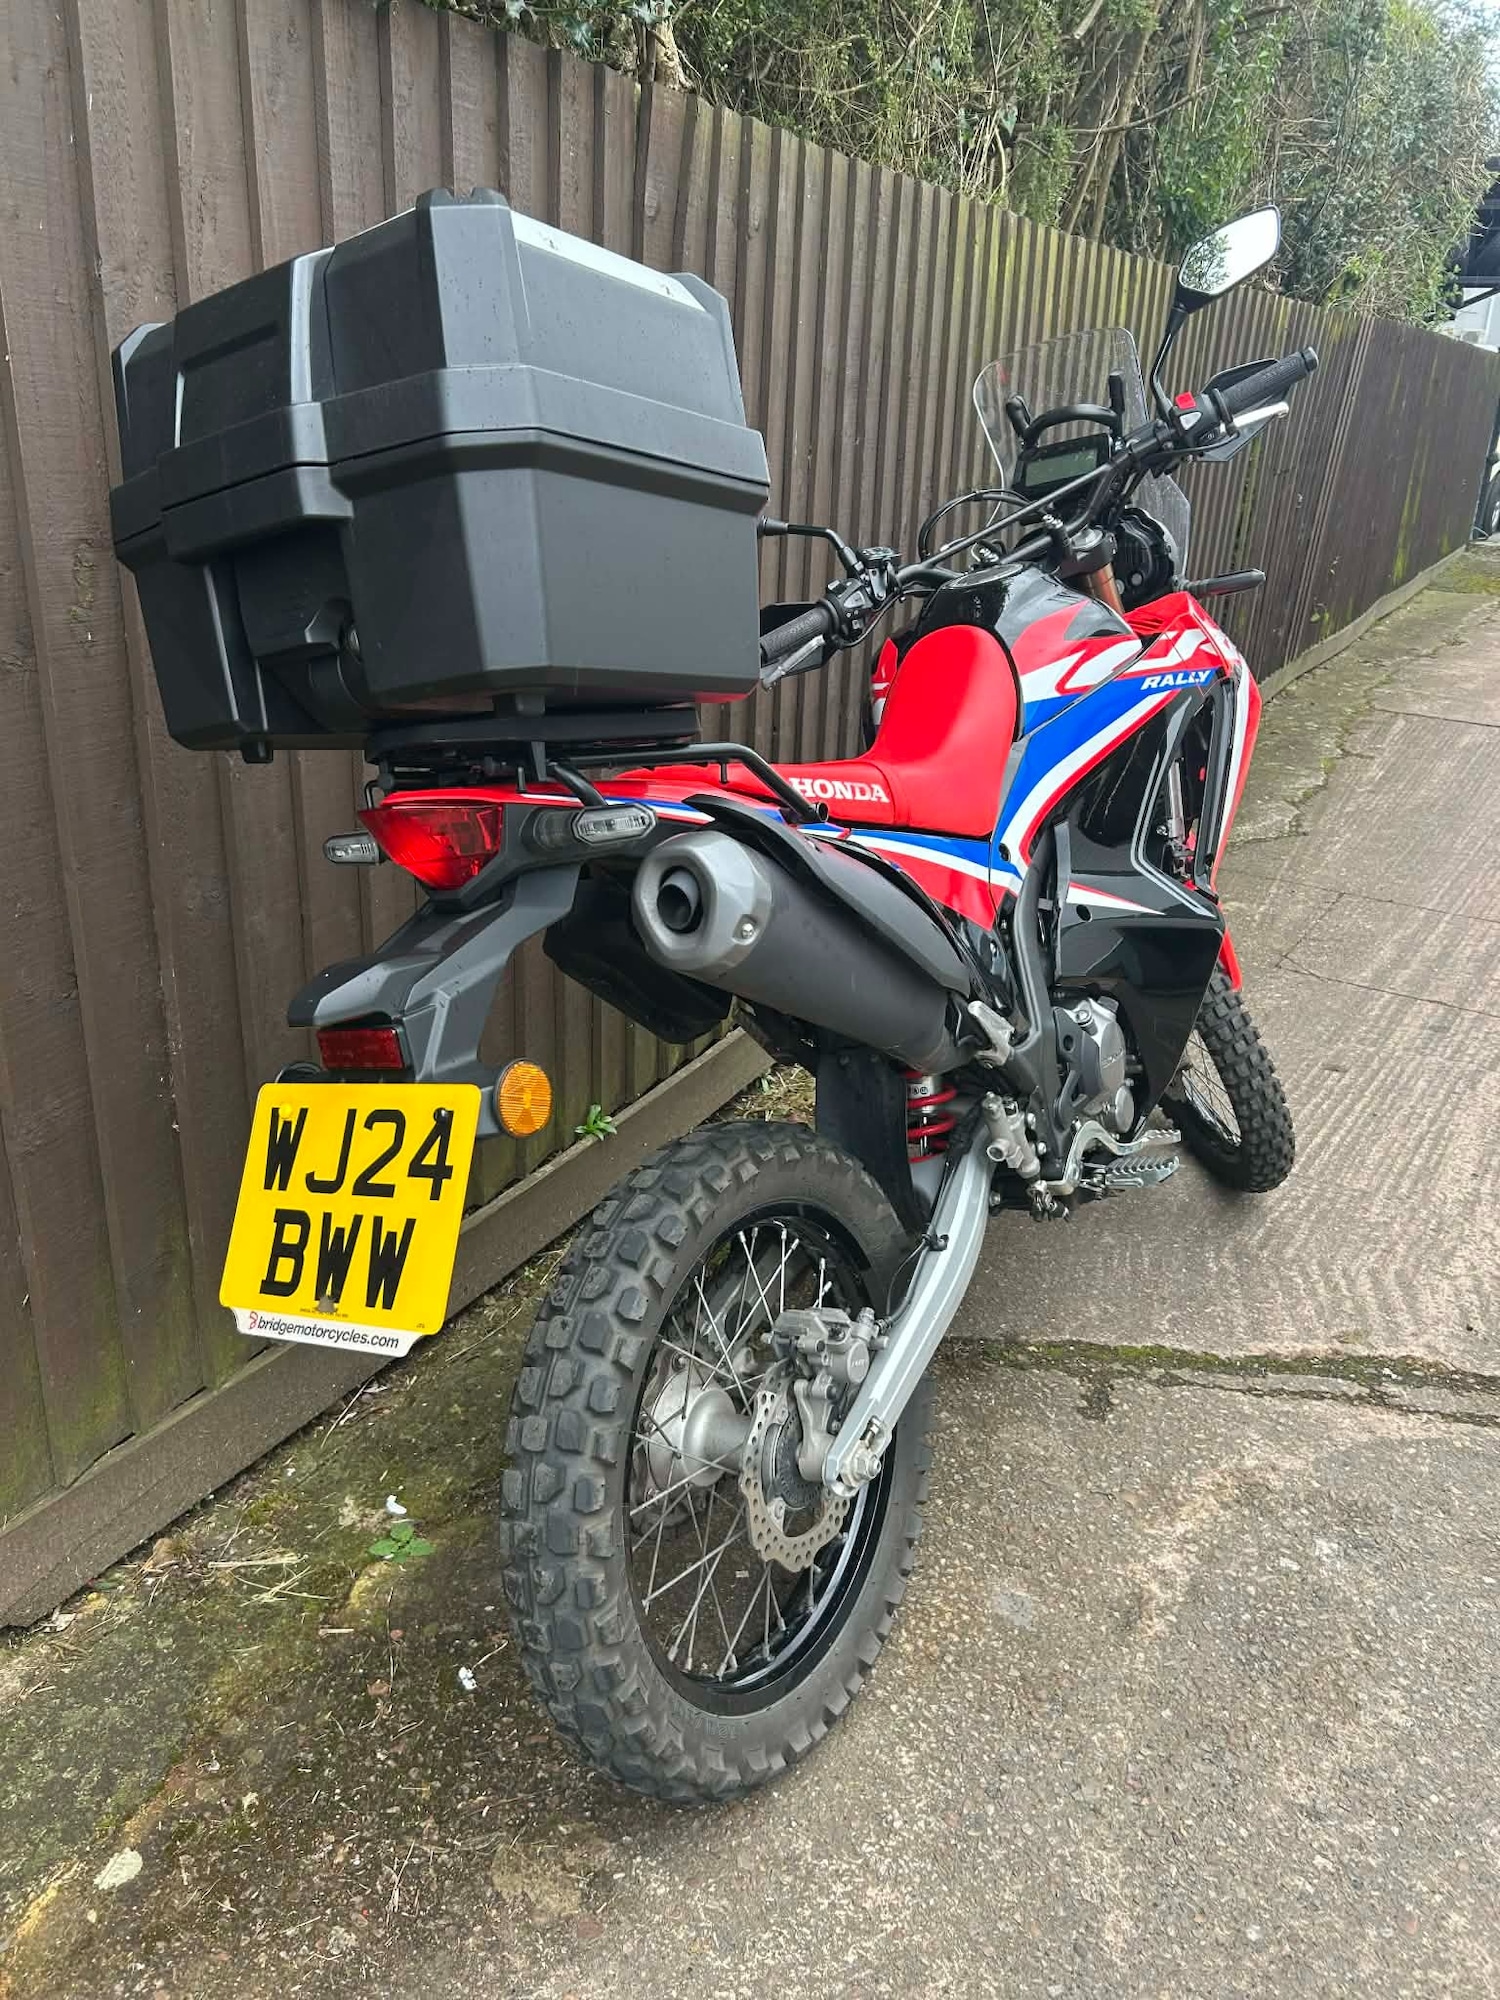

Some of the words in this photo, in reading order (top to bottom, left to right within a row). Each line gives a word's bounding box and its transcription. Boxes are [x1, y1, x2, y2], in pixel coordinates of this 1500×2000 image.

[1141, 670, 1210, 690] RALLY
[790, 777, 889, 803] HONDA
[263, 1107, 455, 1200] WJ24
[259, 1208, 417, 1310] BWW
[258, 1316, 399, 1348] bridgemotorcycles.com
